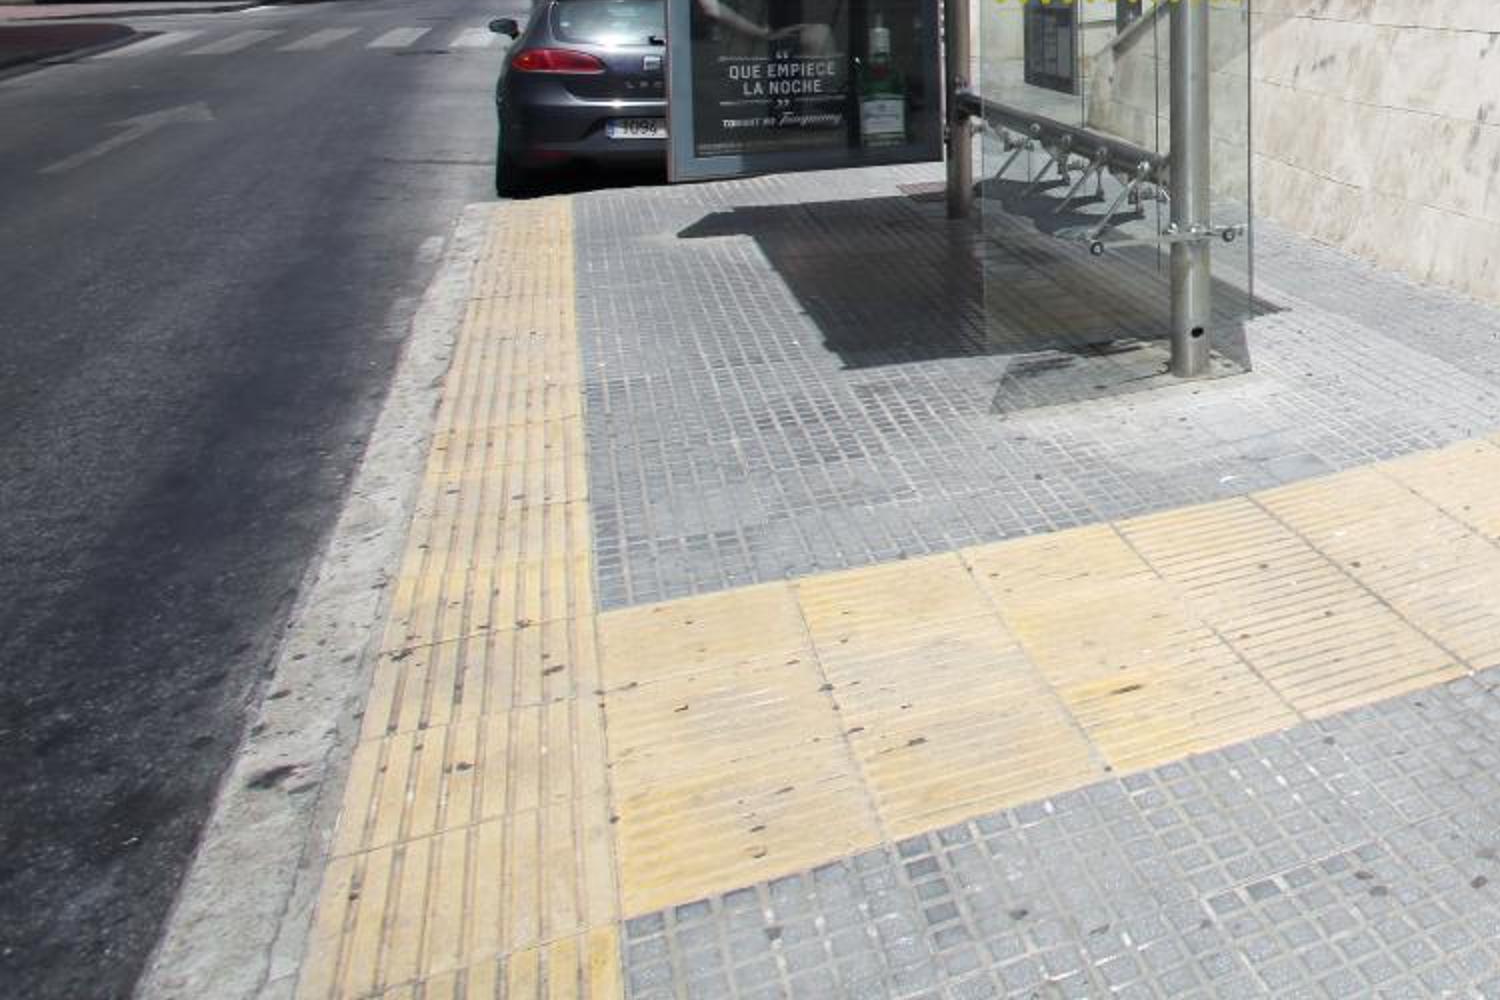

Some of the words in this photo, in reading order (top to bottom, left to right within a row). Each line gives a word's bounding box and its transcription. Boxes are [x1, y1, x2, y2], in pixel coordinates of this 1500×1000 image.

[729, 65, 761, 80] QUE
[768, 61, 836, 78] EMPIECE
[743, 81, 764, 96] LA
[769, 80, 823, 95] NOCHE
